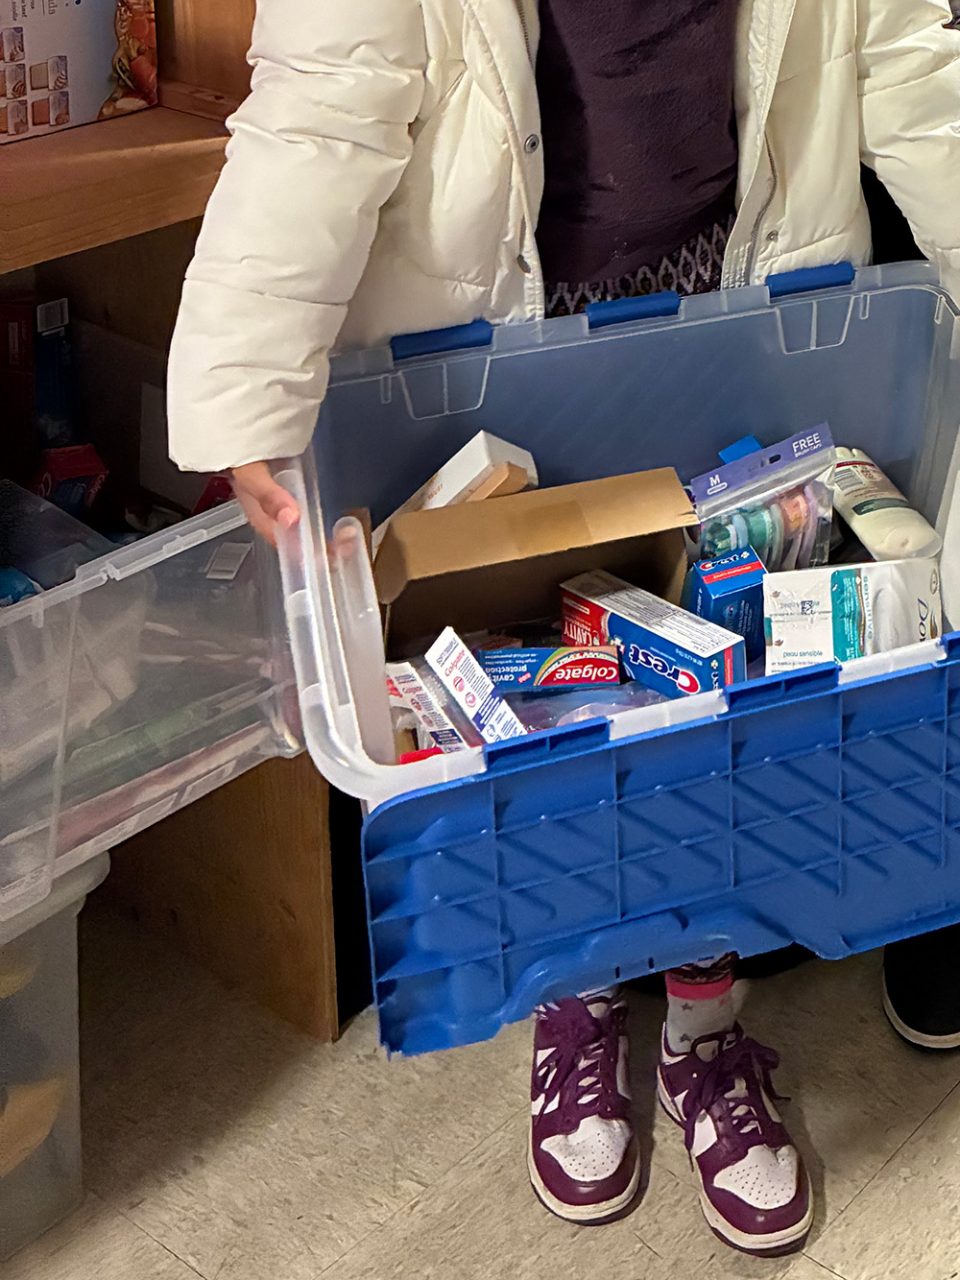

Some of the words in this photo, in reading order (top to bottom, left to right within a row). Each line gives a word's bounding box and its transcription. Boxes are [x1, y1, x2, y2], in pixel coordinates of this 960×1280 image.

[792, 433, 820, 453] FREE
[709, 474, 721, 487] M
[917, 598, 929, 642] Do
[563, 621, 593, 647] CAVITY
[783, 650, 799, 658] peau
[798, 649, 824, 658] sensible
[485, 664, 528, 674] protection
[555, 665, 618, 682] Colgate
[628, 644, 701, 695] Crest
